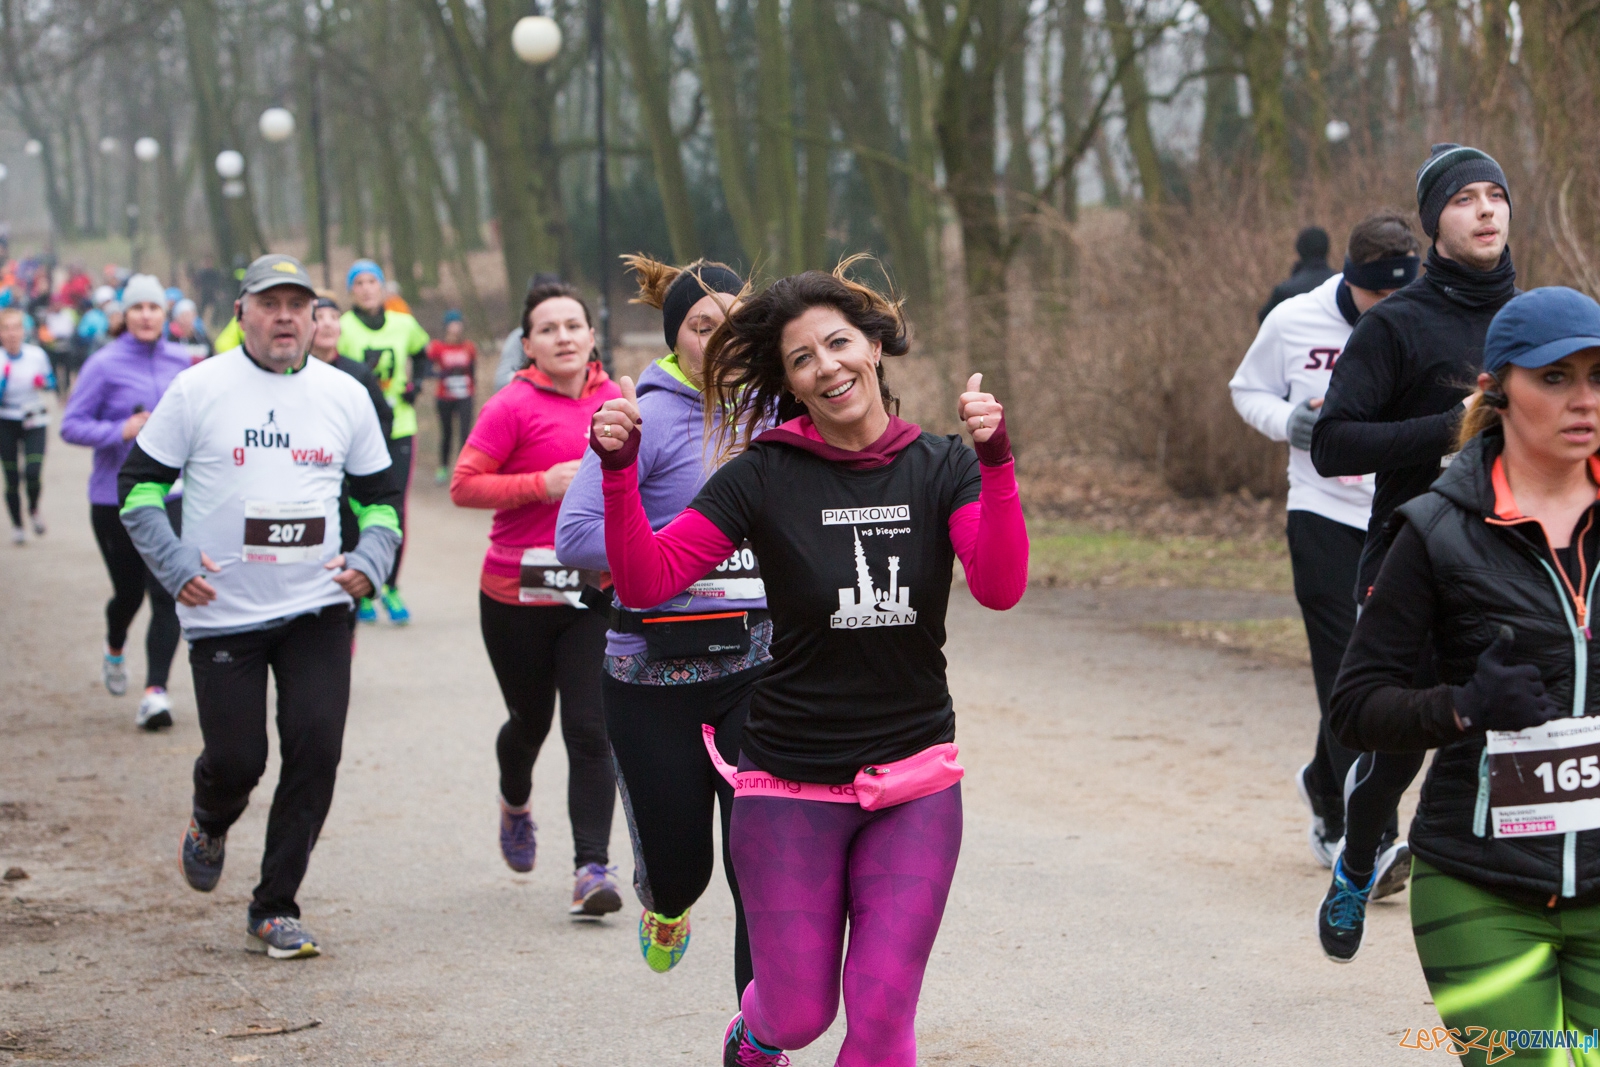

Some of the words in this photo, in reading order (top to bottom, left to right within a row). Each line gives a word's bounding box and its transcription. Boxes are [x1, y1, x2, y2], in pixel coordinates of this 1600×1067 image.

[267, 524, 306, 543] 207
[861, 529, 874, 537] na
[876, 527, 911, 539] biegowo
[543, 570, 580, 588] 364
[1534, 755, 1600, 793] 165
[744, 774, 802, 794] running
